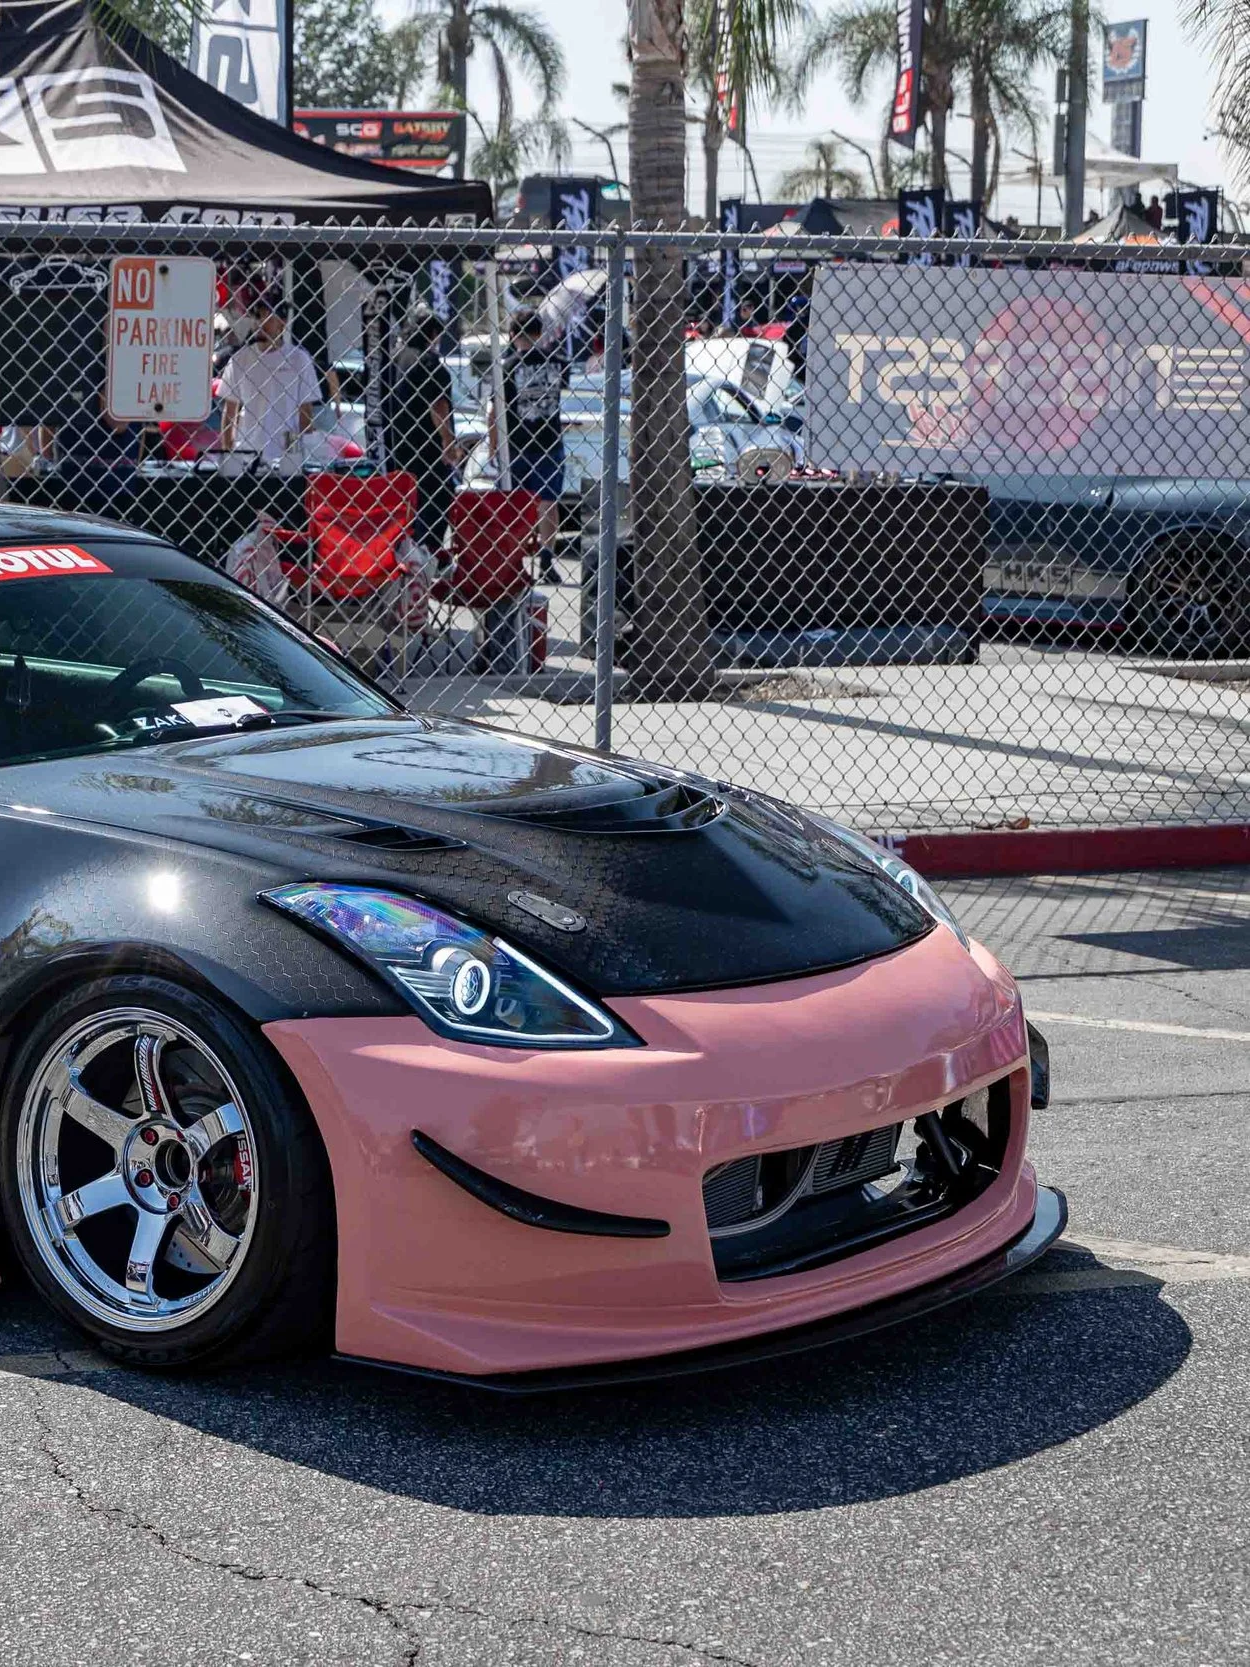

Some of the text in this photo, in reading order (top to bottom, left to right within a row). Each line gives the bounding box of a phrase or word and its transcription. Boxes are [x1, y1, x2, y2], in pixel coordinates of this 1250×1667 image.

[117, 268, 151, 304] NO
[116, 317, 207, 348] PARKING
[142, 353, 181, 376] FIRE
[137, 382, 182, 405] LANE
